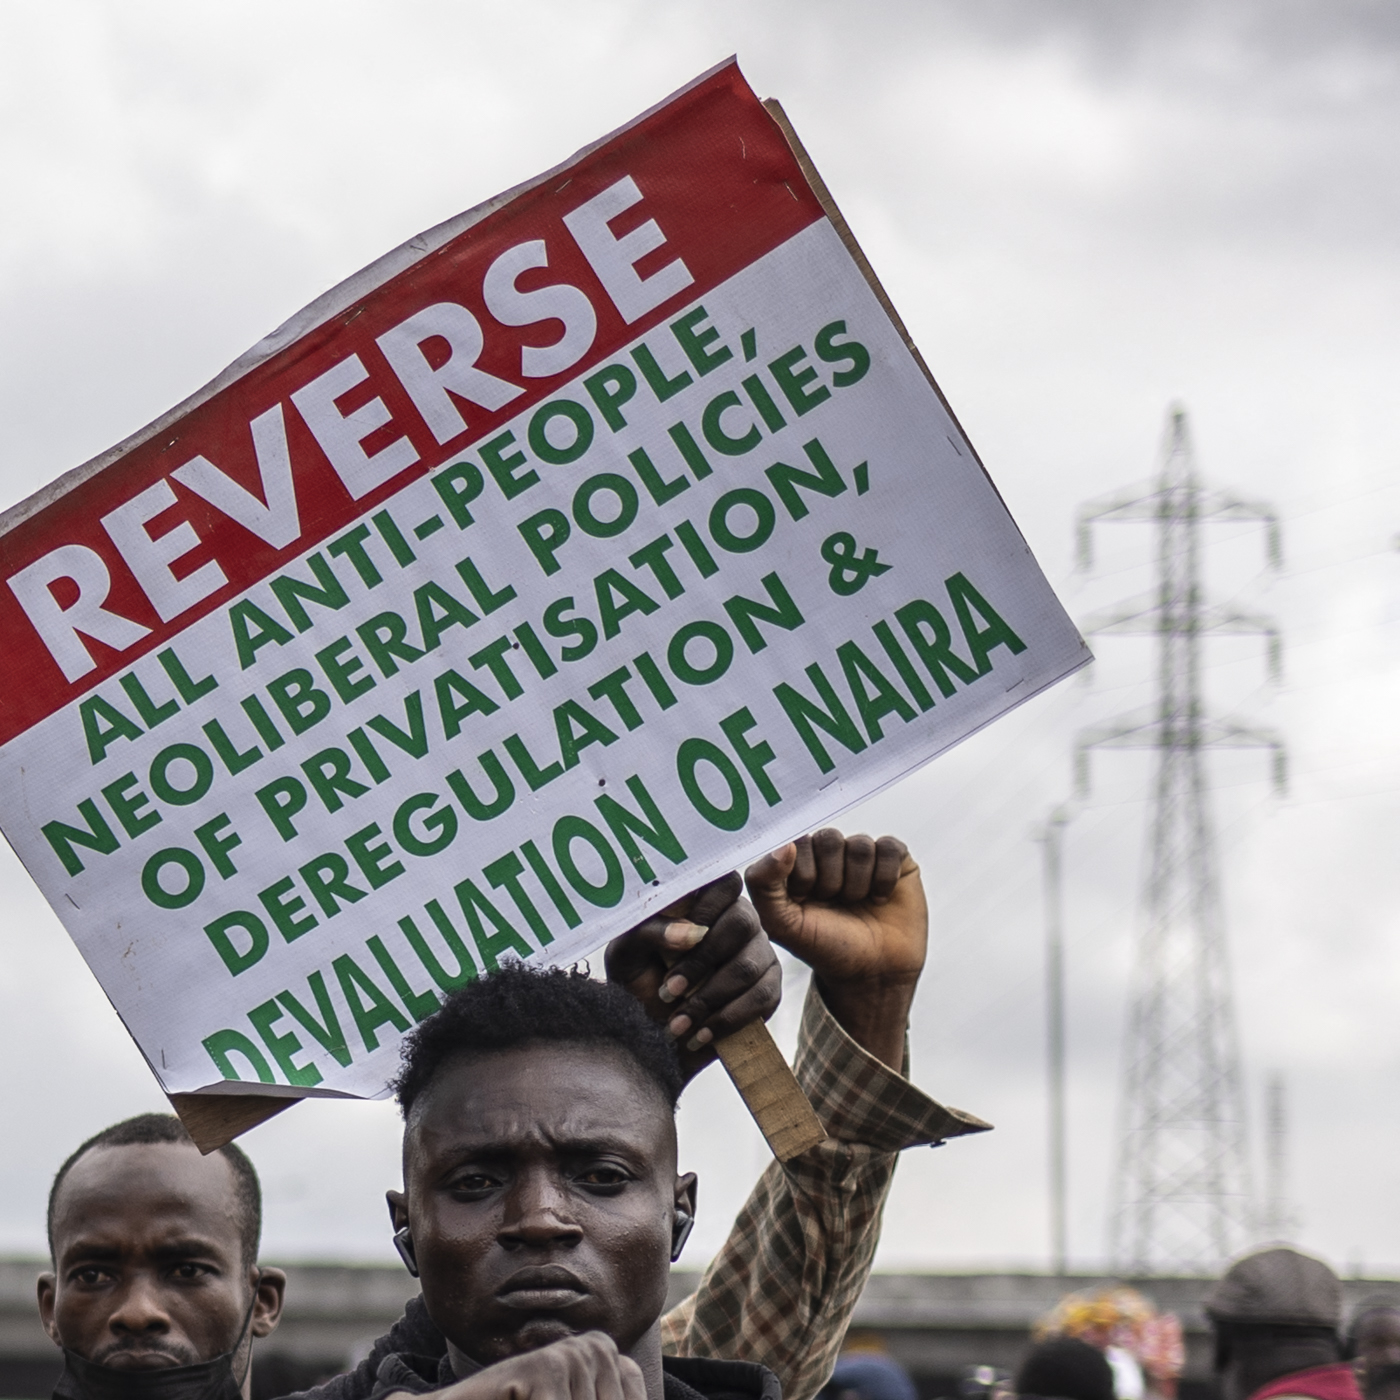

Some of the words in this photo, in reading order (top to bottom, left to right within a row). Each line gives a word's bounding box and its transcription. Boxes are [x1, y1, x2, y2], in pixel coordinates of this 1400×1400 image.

[6, 173, 696, 685] REVERSE
[41, 559, 516, 876] NEOLIBERAL
[519, 320, 871, 574] POLICIES
[79, 649, 217, 764] ALL
[230, 306, 758, 669] ANTI-PEOPLE,
[141, 813, 242, 910] OF
[256, 438, 869, 841] PRIVATISATION,
[201, 775, 688, 1088] DEVALUATION
[677, 707, 782, 831] OF
[774, 572, 1027, 773] NAIRA
[203, 571, 804, 976] DEREGULATION
[822, 530, 892, 596] &
